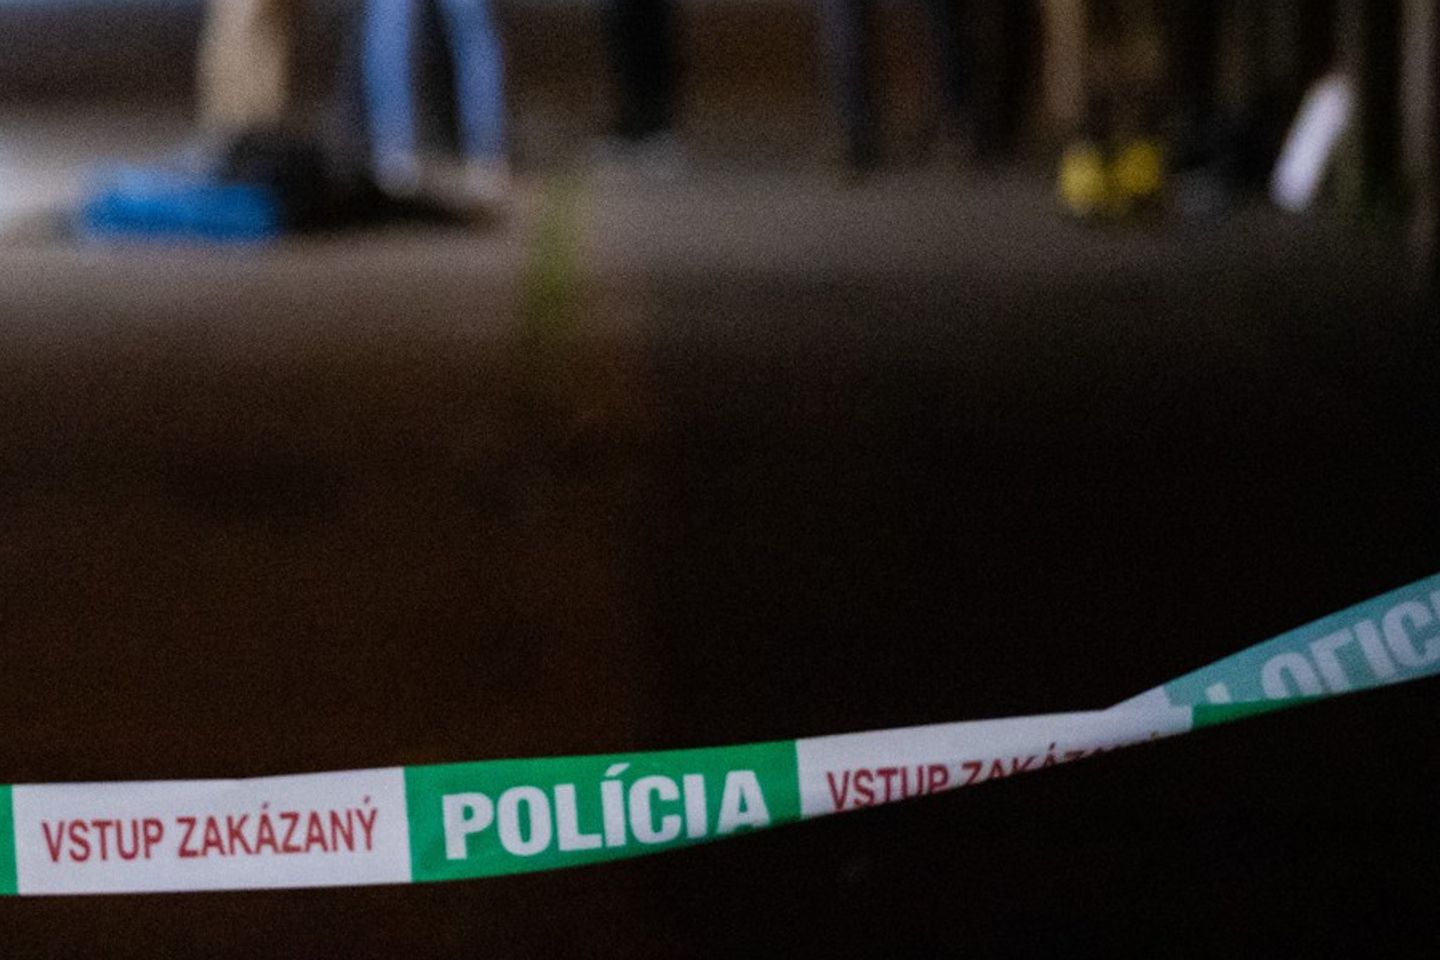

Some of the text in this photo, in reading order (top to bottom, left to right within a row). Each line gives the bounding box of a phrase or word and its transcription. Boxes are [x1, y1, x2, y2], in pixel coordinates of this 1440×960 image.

[441, 762, 771, 861] POLÍCIA
[826, 762, 950, 810] VSTUP
[41, 795, 378, 863] VSTUP ZAKÁZANÝ
